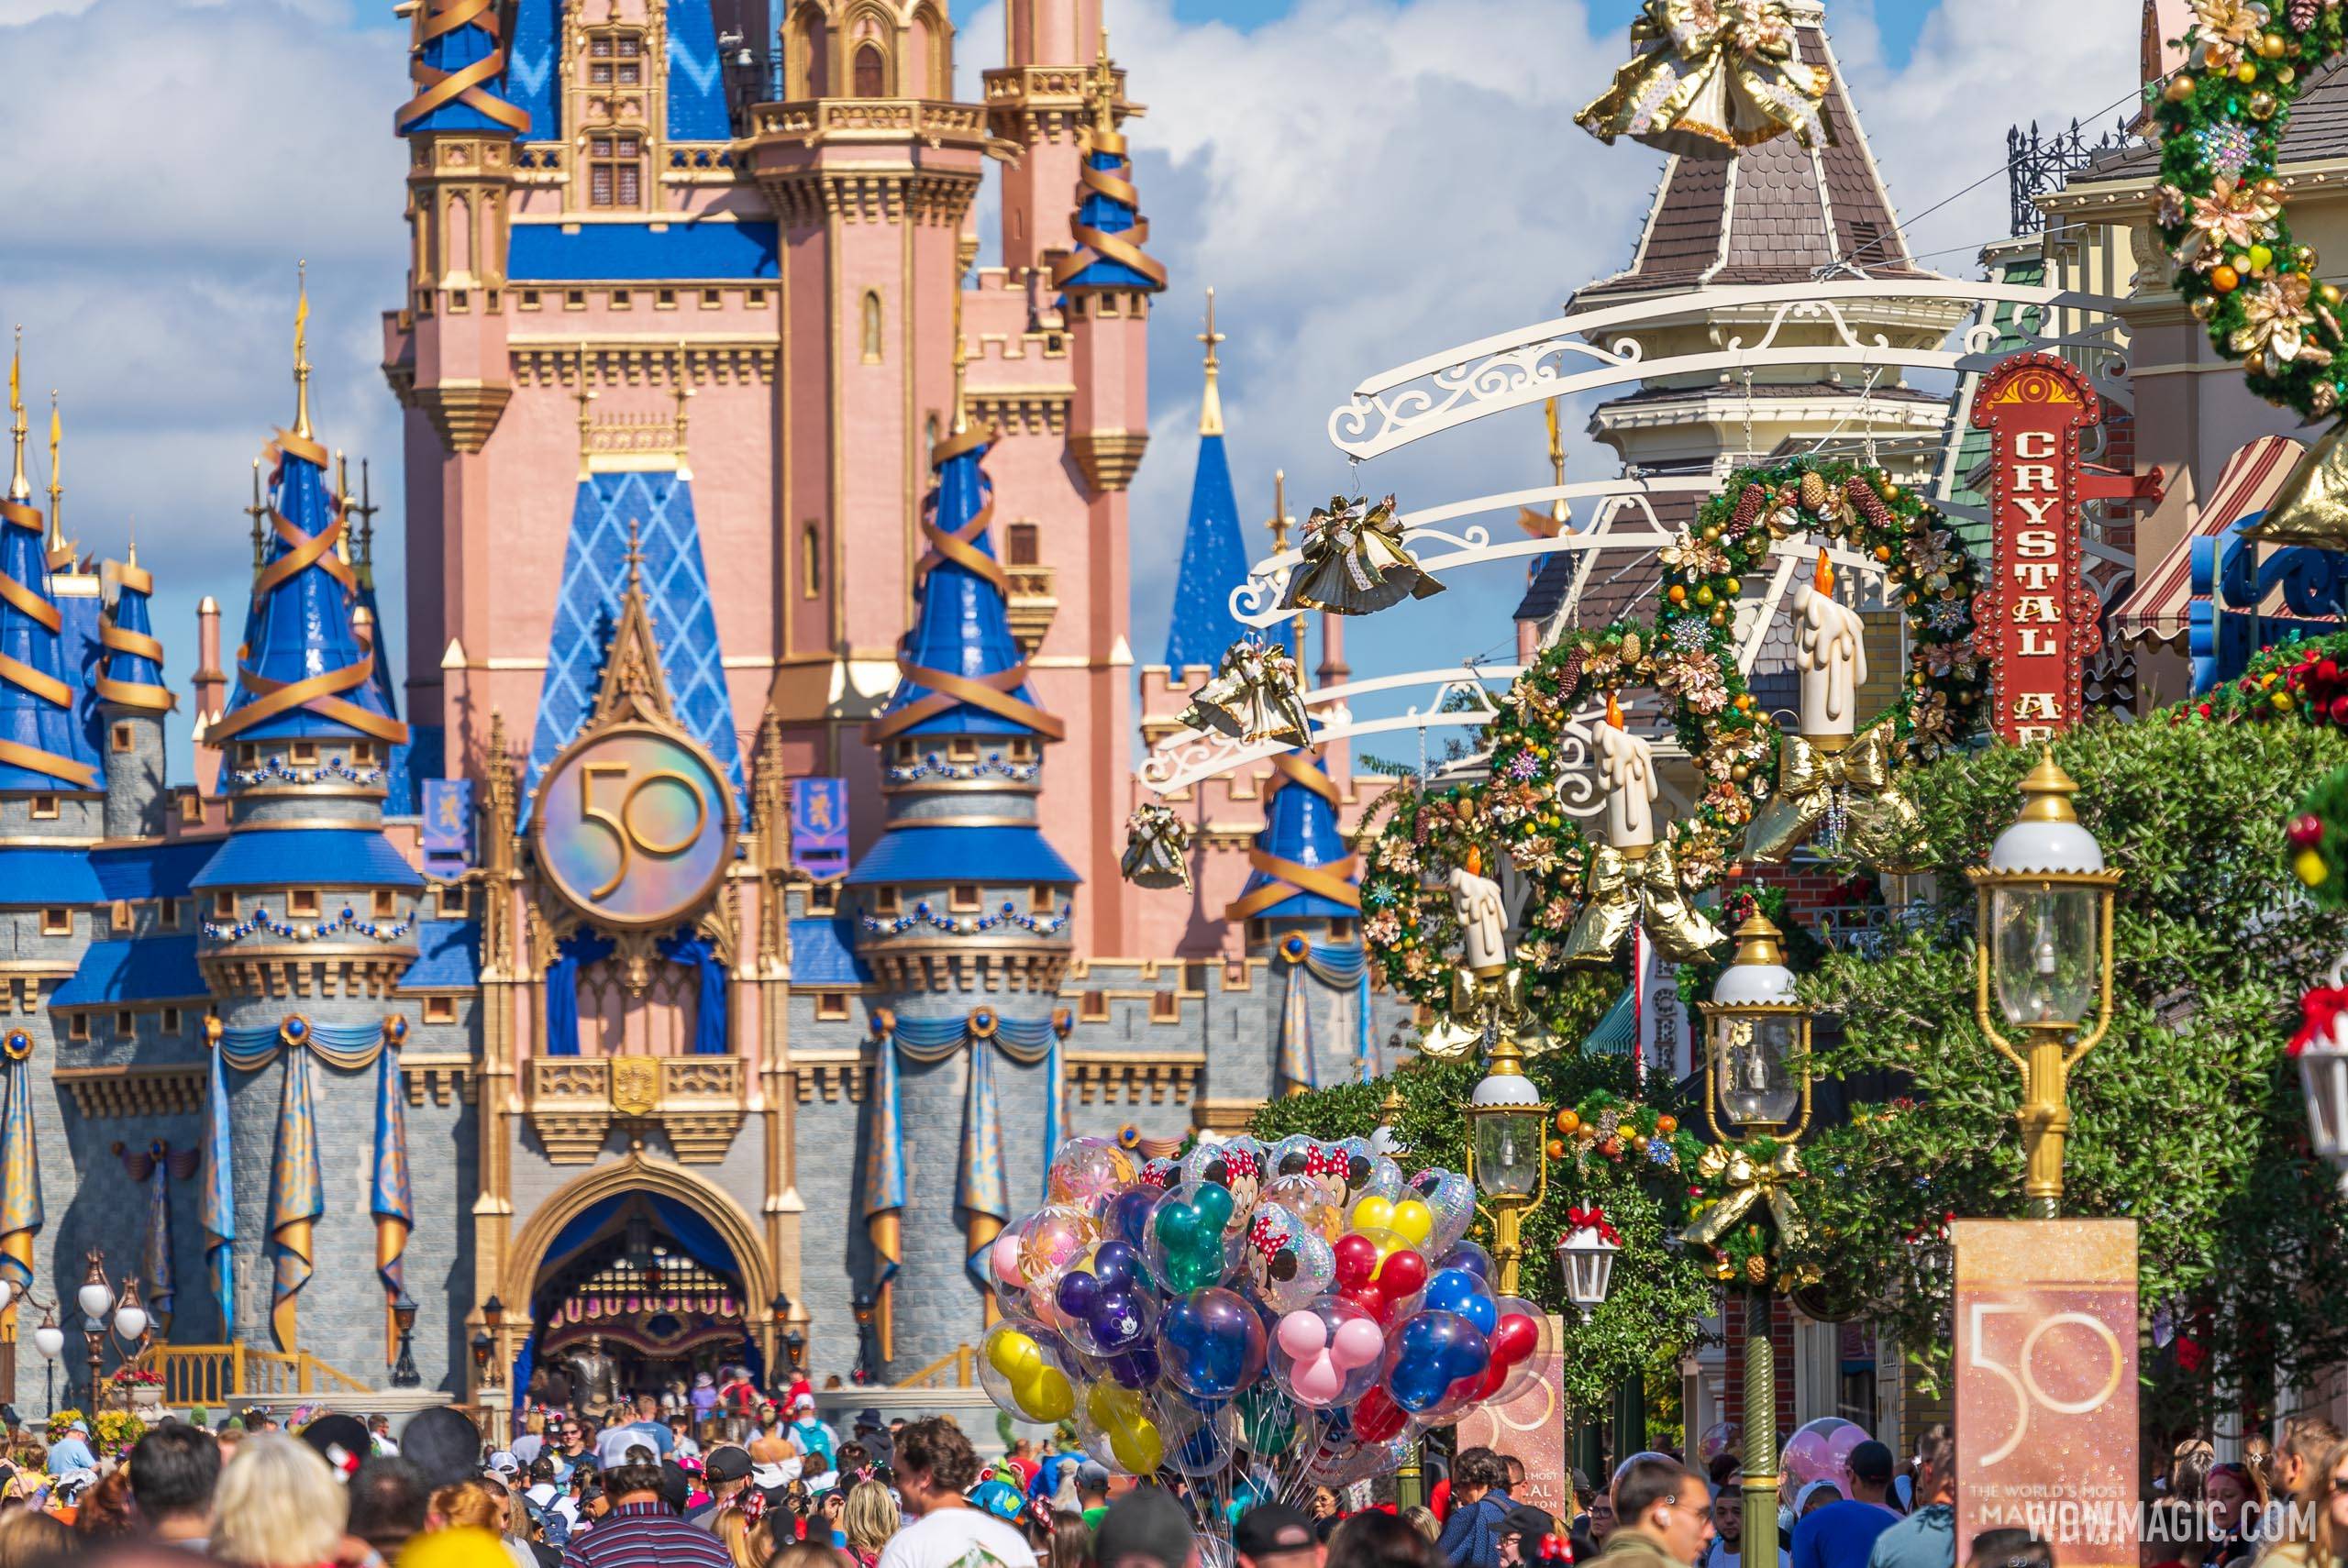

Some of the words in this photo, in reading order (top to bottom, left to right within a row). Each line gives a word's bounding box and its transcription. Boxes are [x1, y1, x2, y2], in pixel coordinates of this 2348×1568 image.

[2012, 431, 2061, 656] CRYSTAL
[581, 761, 707, 900] 50
[1970, 1303, 2123, 1468] 50
[1531, 1472, 1556, 1481] MOST
[1971, 1485, 1999, 1498] THE
[2005, 1485, 2077, 1498] WORLD'S
[2083, 1485, 2127, 1498] MOST
